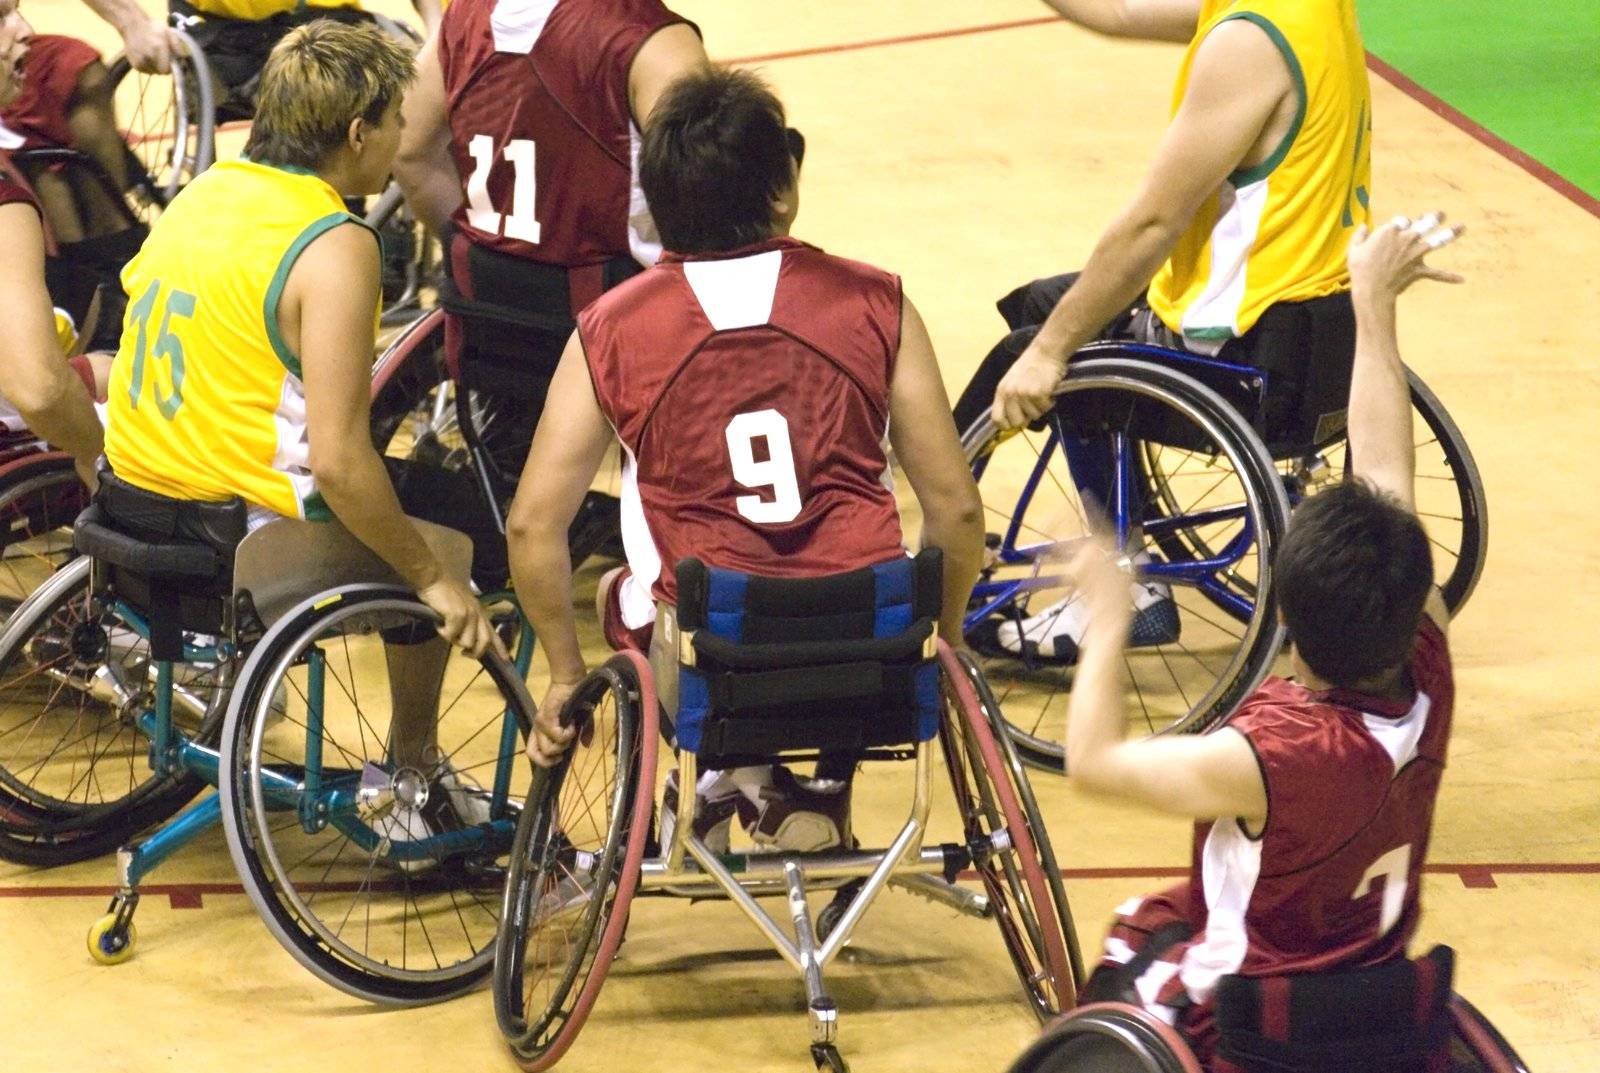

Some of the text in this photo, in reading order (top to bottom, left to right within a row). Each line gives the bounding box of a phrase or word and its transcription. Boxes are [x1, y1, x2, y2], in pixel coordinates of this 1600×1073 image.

[465, 134, 541, 245] 11
[128, 278, 197, 421] 15
[725, 408, 803, 523] 9
